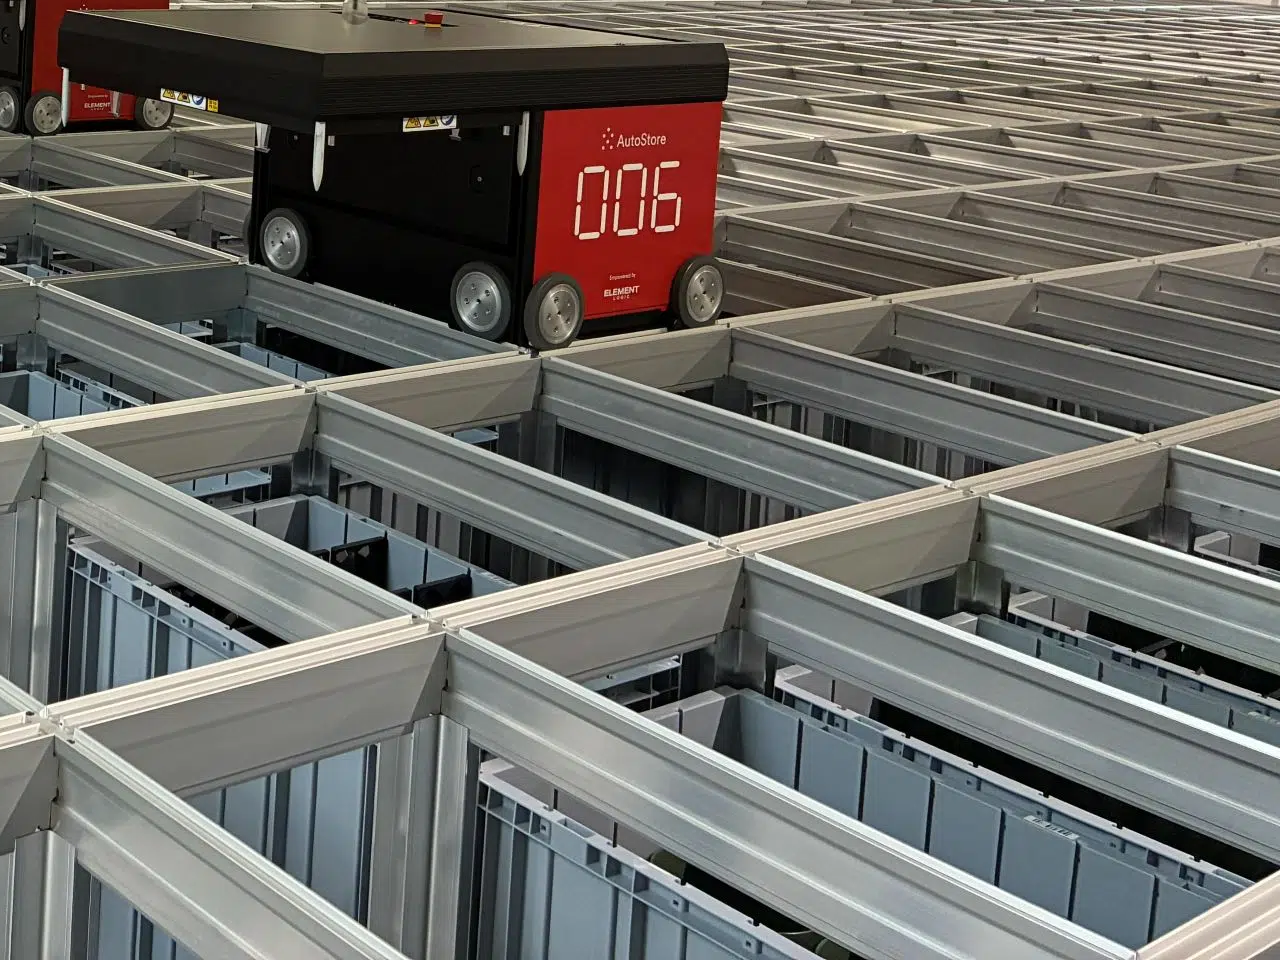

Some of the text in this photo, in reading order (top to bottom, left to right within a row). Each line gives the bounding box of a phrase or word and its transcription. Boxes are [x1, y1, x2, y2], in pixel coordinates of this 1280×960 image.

[616, 133, 667, 148] AutoStore
[574, 160, 682, 241] 006
[603, 285, 640, 298] ELEMENT
